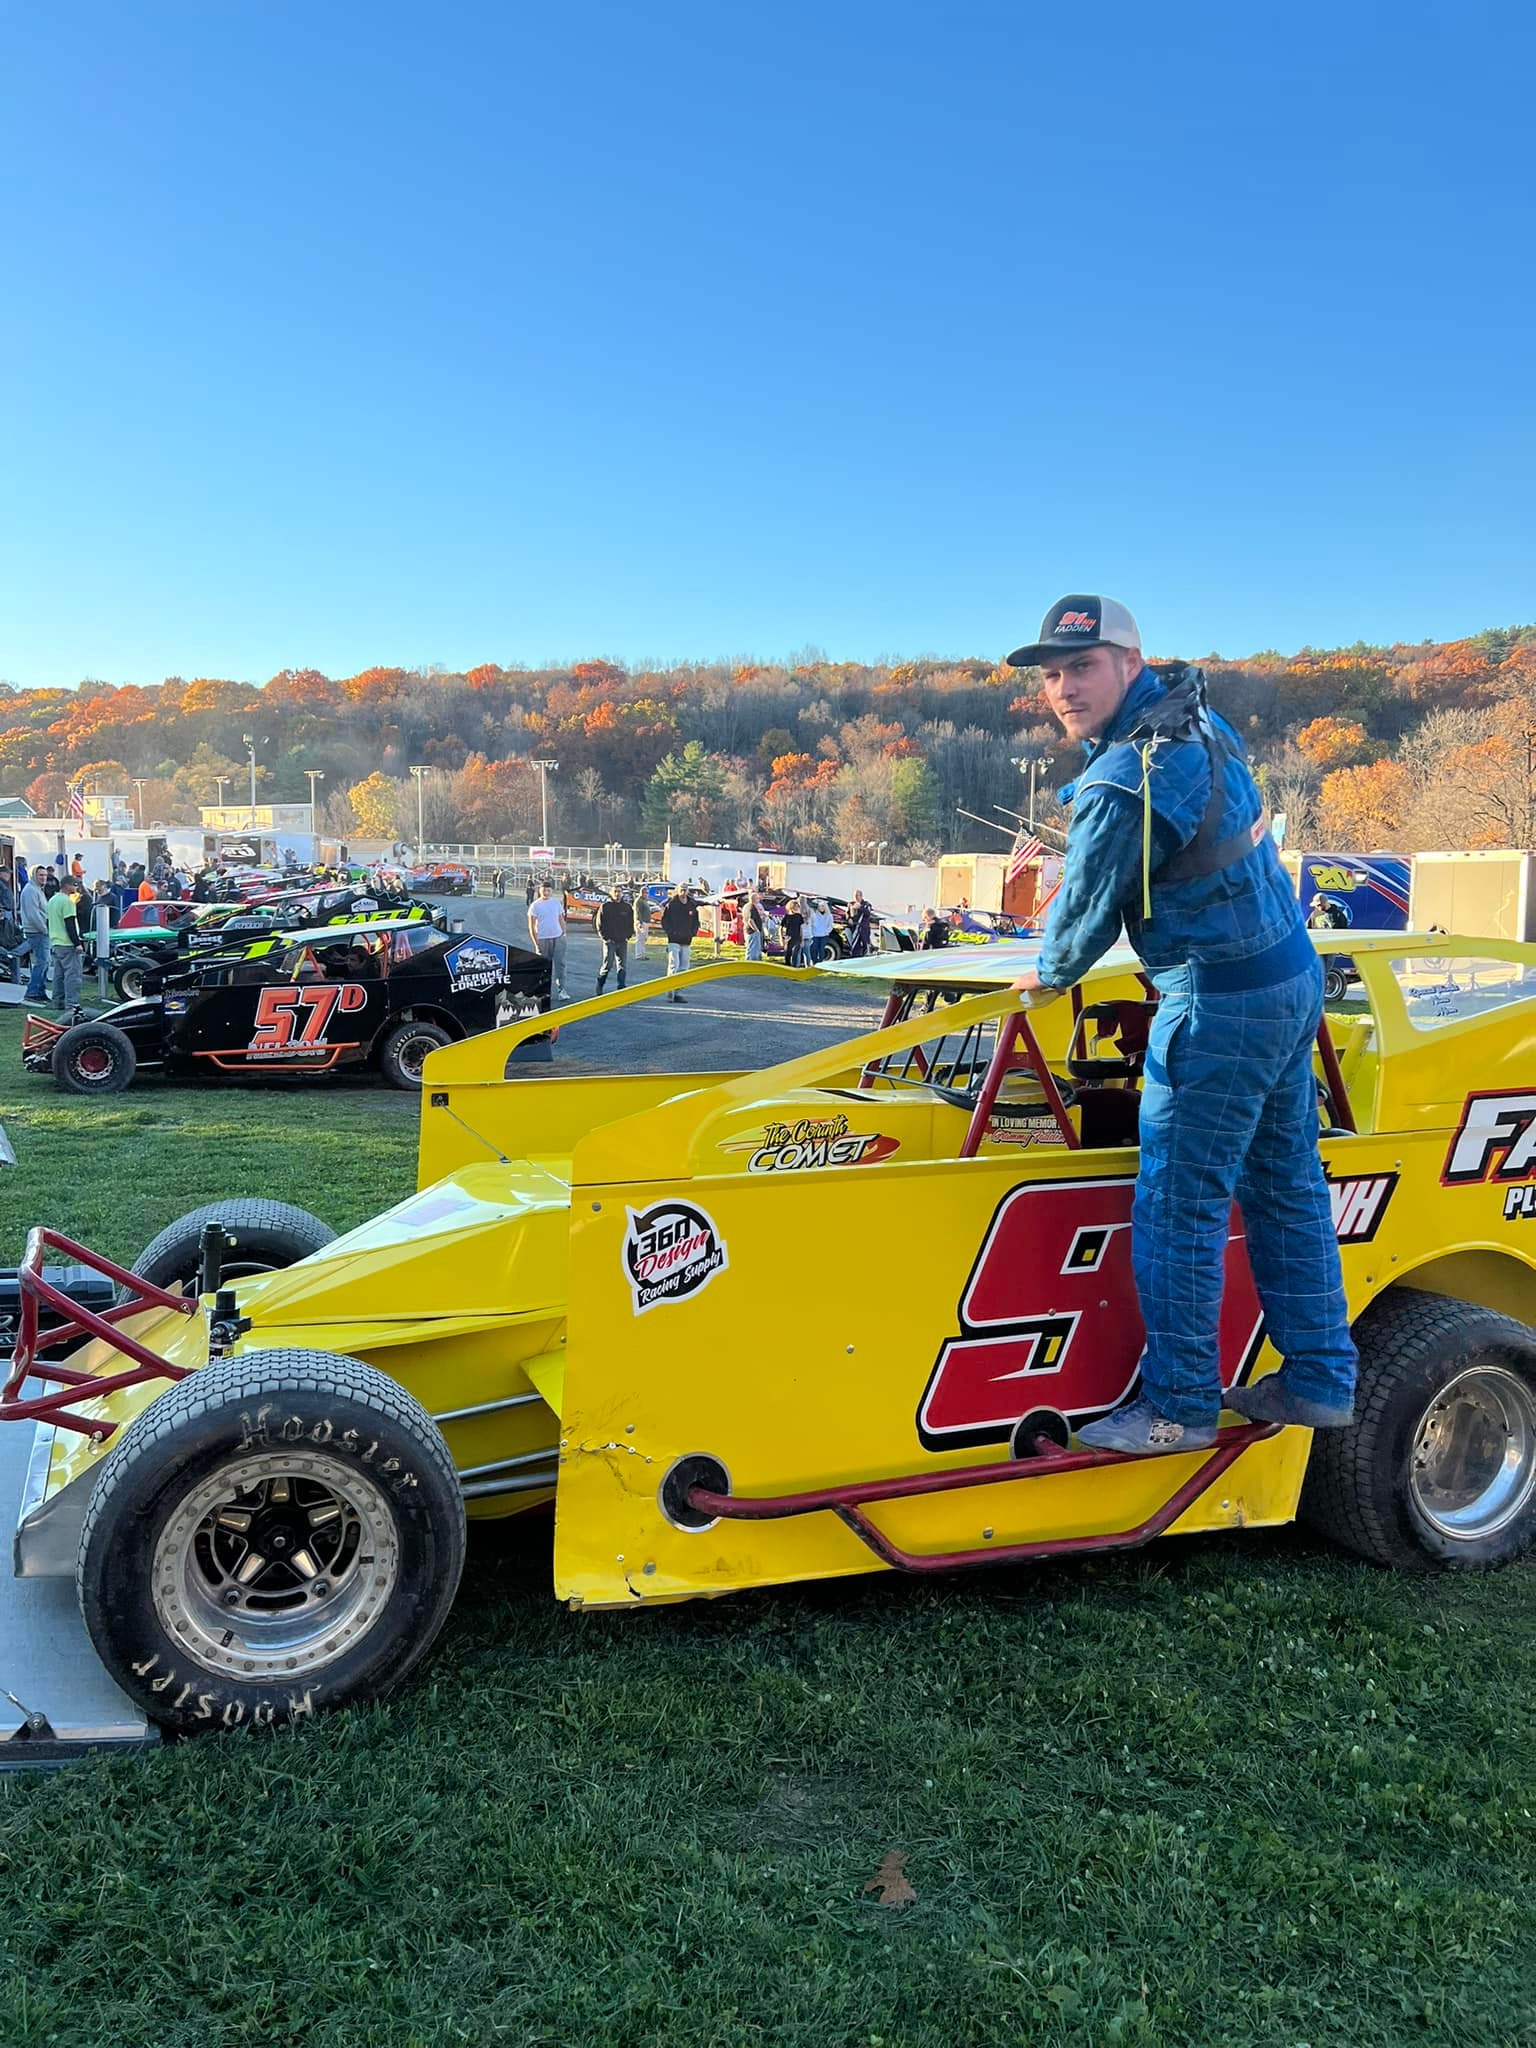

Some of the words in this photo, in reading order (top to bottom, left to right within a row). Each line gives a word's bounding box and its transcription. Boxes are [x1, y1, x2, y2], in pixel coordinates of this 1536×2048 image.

[1054, 624, 1094, 634] FADDEN
[450, 974, 512, 993] CONCRETE
[764, 1122, 791, 1149] The
[1000, 1117, 1027, 1129] LOVING
[1028, 1118, 1061, 1129] MEMOR
[748, 1133, 881, 1172] COMET
[639, 1217, 691, 1258] 360
[634, 1229, 711, 1281] Design
[640, 1275, 681, 1304] Racing
[684, 1251, 721, 1284] Supply
